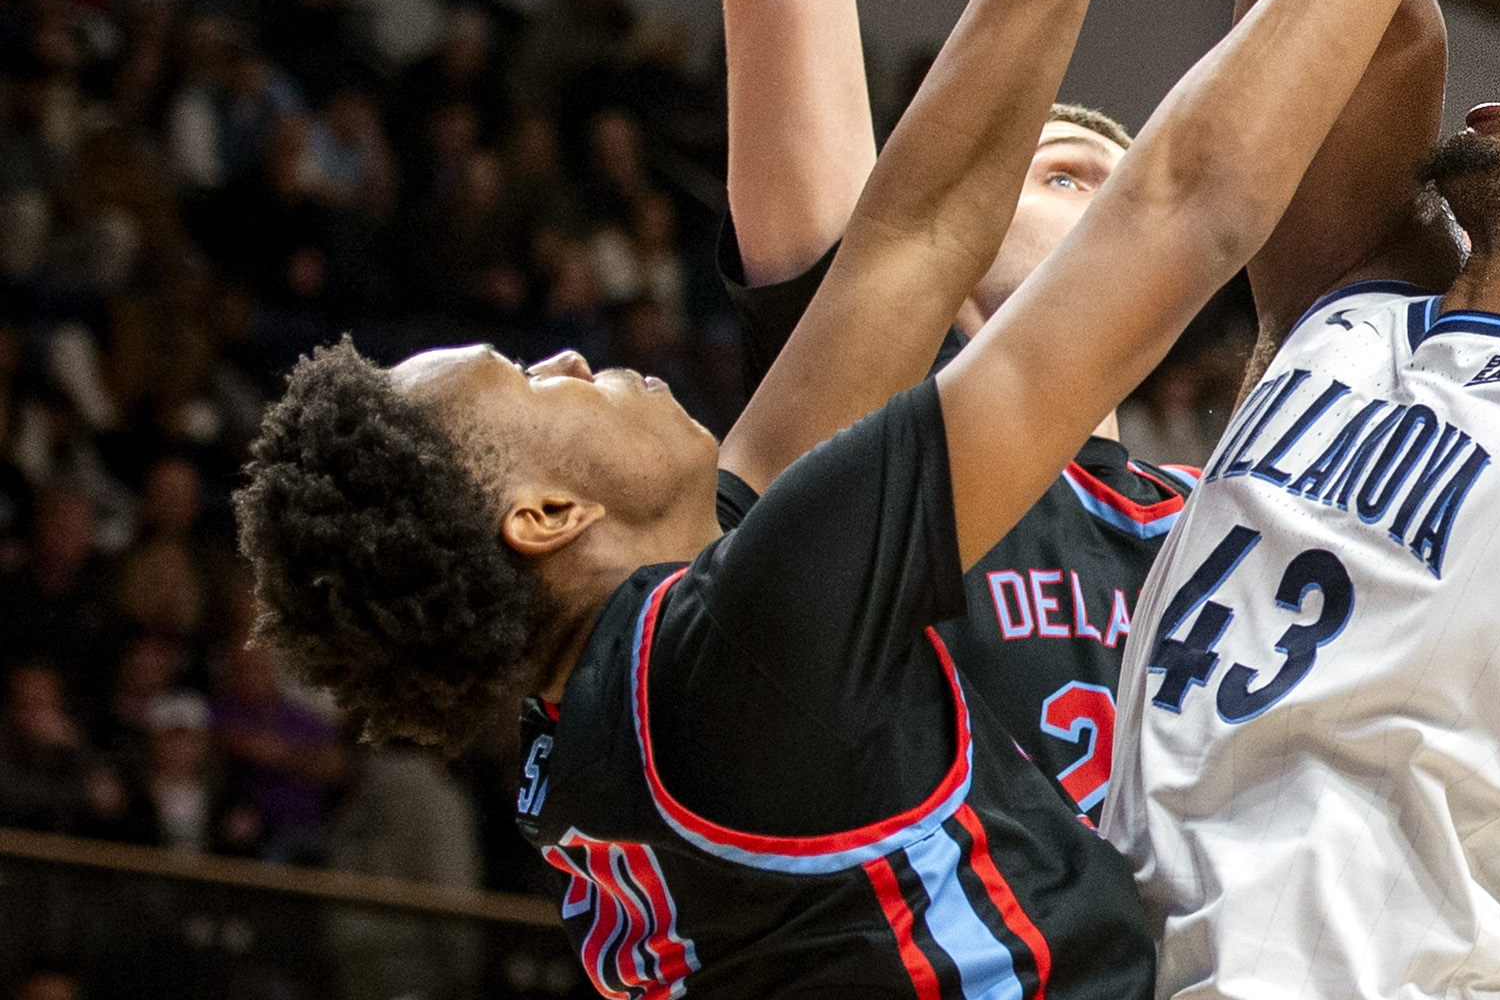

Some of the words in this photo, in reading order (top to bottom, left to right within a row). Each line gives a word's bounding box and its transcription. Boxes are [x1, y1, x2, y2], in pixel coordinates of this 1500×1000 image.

[1203, 368, 1492, 580] ILLANOVA
[985, 567, 1142, 648] DELA
[1146, 524, 1356, 725] 43
[1039, 679, 1117, 814] 2
